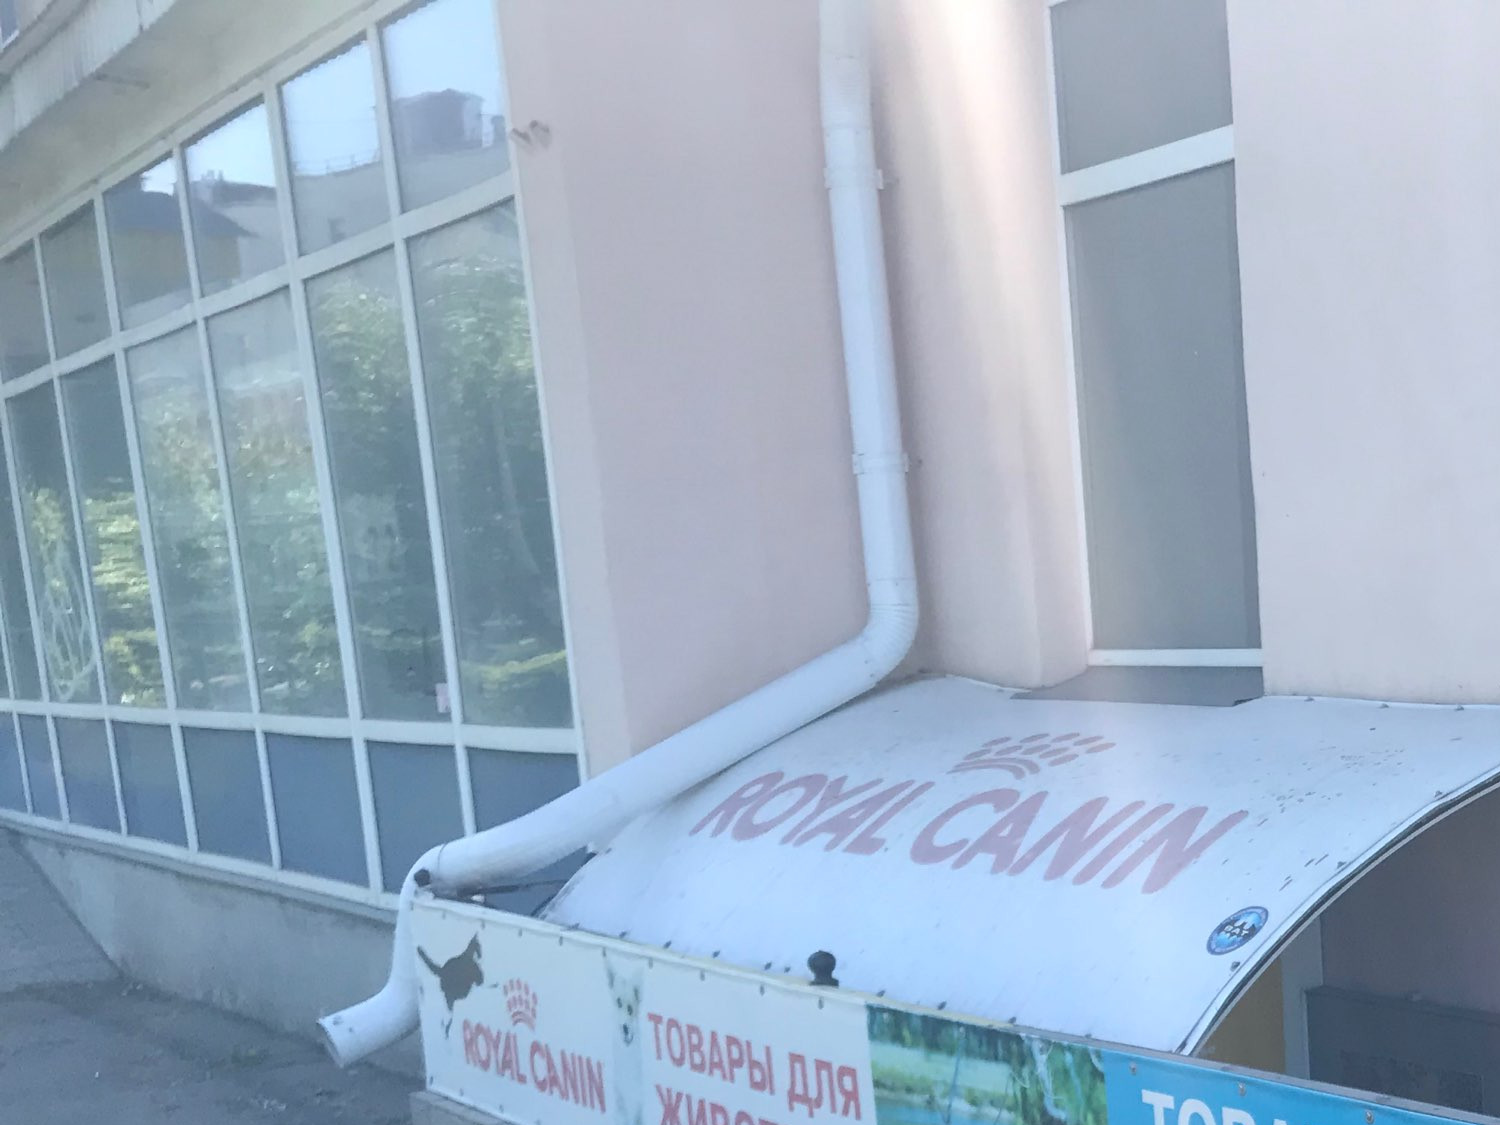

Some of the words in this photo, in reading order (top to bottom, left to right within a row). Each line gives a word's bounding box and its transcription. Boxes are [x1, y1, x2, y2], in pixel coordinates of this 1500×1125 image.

[688, 771, 935, 855] ROYAL
[909, 788, 1249, 894] CANIN
[462, 1019, 527, 1085] ROYAL
[529, 1040, 606, 1113] CANIN
[647, 1012, 776, 1096] ТОВАРЫ
[786, 1052, 862, 1120] ДЛЯ
